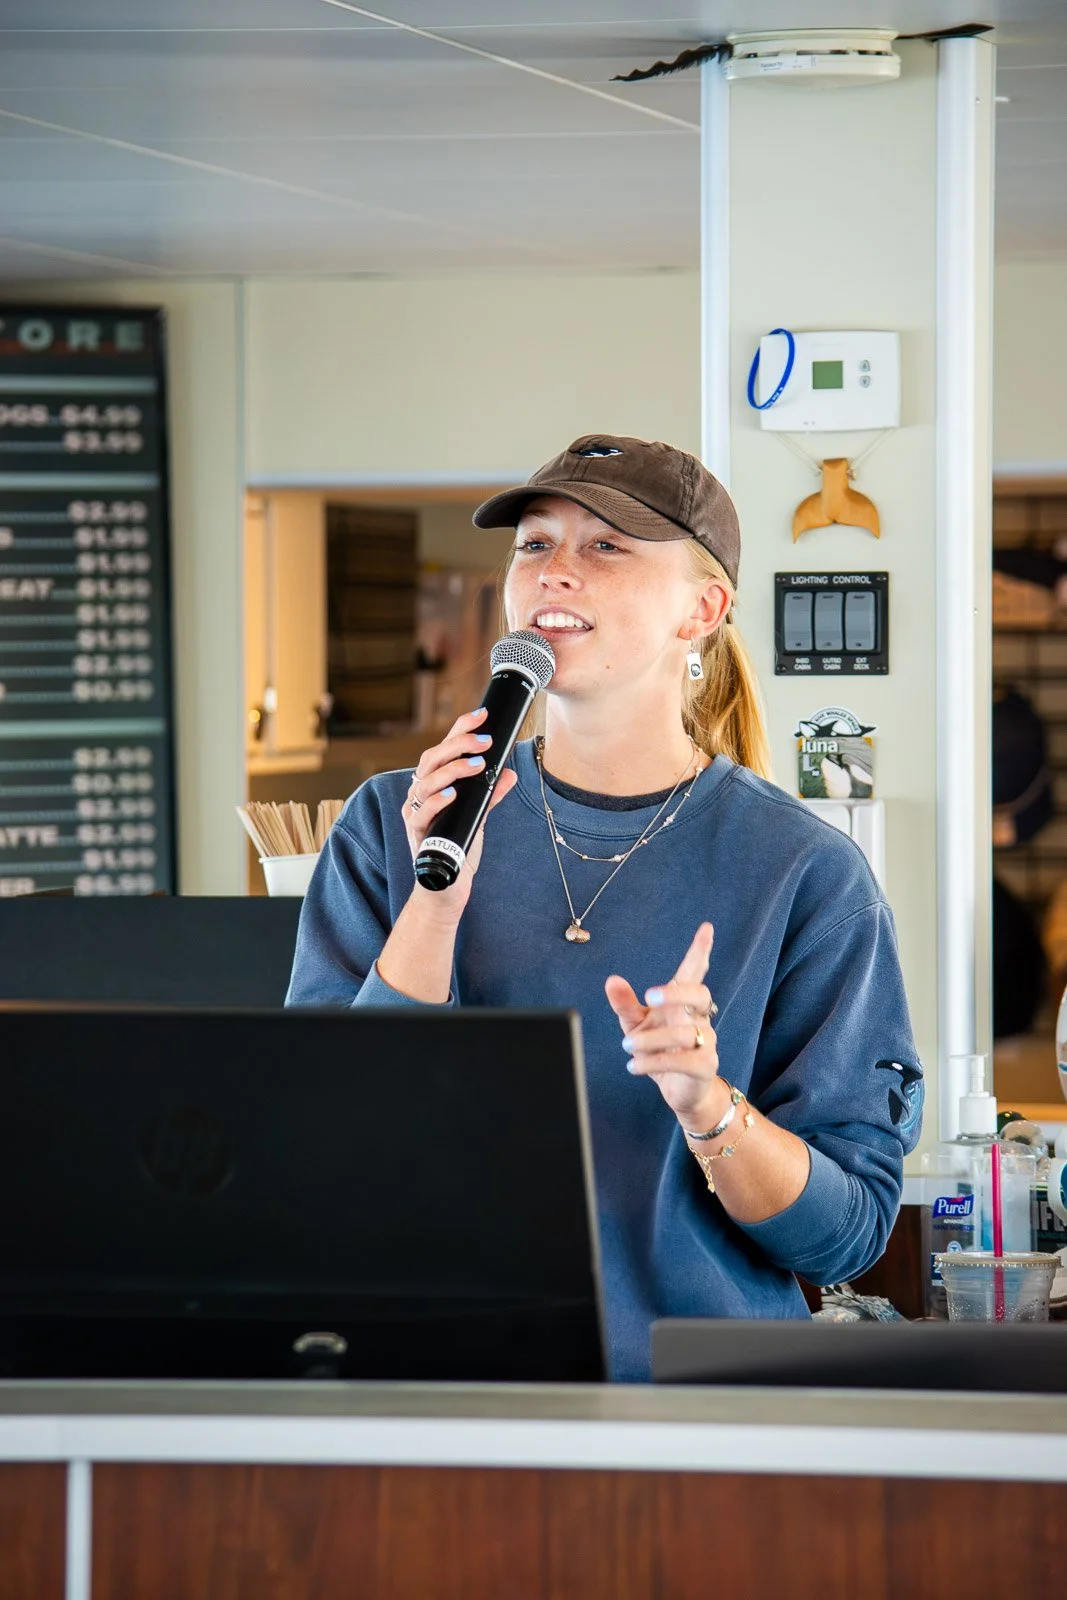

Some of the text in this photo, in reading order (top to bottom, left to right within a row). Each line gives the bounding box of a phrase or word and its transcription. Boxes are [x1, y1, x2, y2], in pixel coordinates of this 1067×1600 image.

[0, 319, 145, 350] ORE
[791, 575, 872, 584] LIGHTING CONTROL
[802, 737, 838, 753] luna
[425, 840, 461, 858] NATURA
[937, 1199, 971, 1214] Purell
